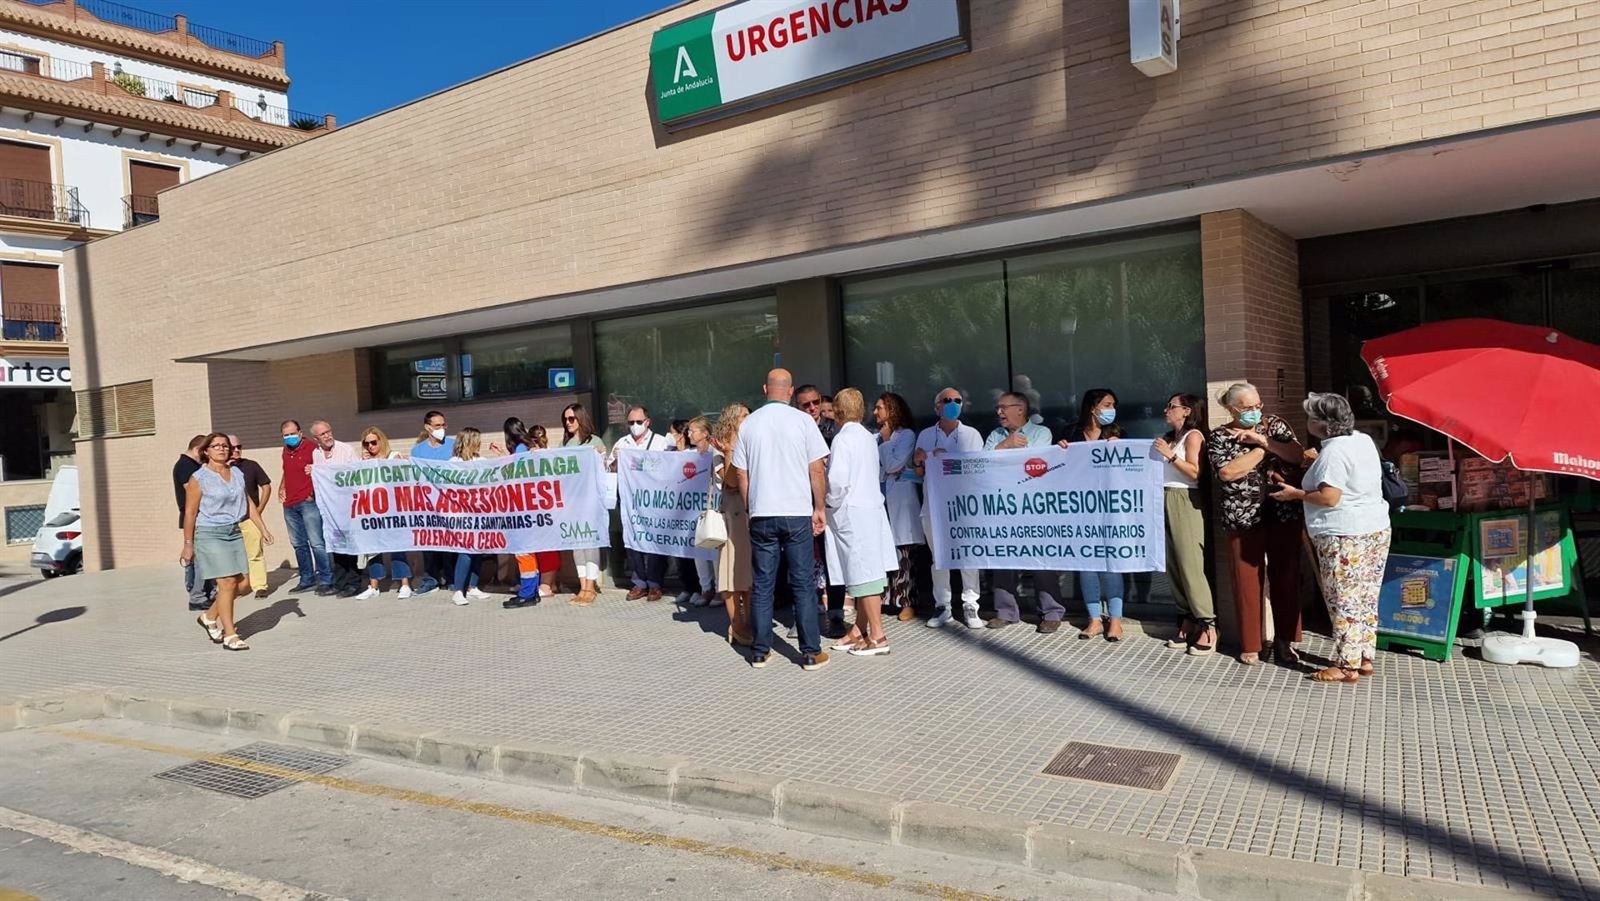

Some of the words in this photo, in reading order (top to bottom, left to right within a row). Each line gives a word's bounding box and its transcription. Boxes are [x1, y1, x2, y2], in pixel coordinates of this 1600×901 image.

[660, 89, 676, 99] Junta
[677, 85, 684, 94] de
[685, 75, 714, 91] Andalucía
[1091, 446, 1144, 464] SMA
[334, 464, 421, 487] SINDICATO
[479, 466, 500, 484] DE
[500, 455, 580, 481] MÁLAGA
[1026, 463, 1046, 471] STOP
[350, 486, 389, 519] ¡NO
[394, 482, 434, 513] MÁS
[435, 480, 564, 514] AGRESIONES!
[652, 486, 675, 509] MÁS
[947, 494, 979, 521] ¡¡NO
[982, 488, 1017, 516] MÁS
[1022, 489, 1144, 514] AGRESIONES!!
[361, 515, 407, 530] CONTRA
[409, 514, 425, 528] LAS
[473, 516, 479, 530] A
[480, 513, 554, 530] SANITARIAS-OS
[560, 521, 598, 539] SMA
[654, 518, 666, 529] LAS
[478, 531, 507, 549] CERO
[950, 526, 988, 539] CONTRA
[989, 526, 1008, 539] LAS
[1010, 525, 1073, 538] AGRESIONES
[1075, 525, 1083, 538] A
[1084, 524, 1145, 539] SANITARIOS
[951, 544, 1076, 560] ¡¡TOLERANCIA
[1080, 545, 1146, 559] CERO!!
